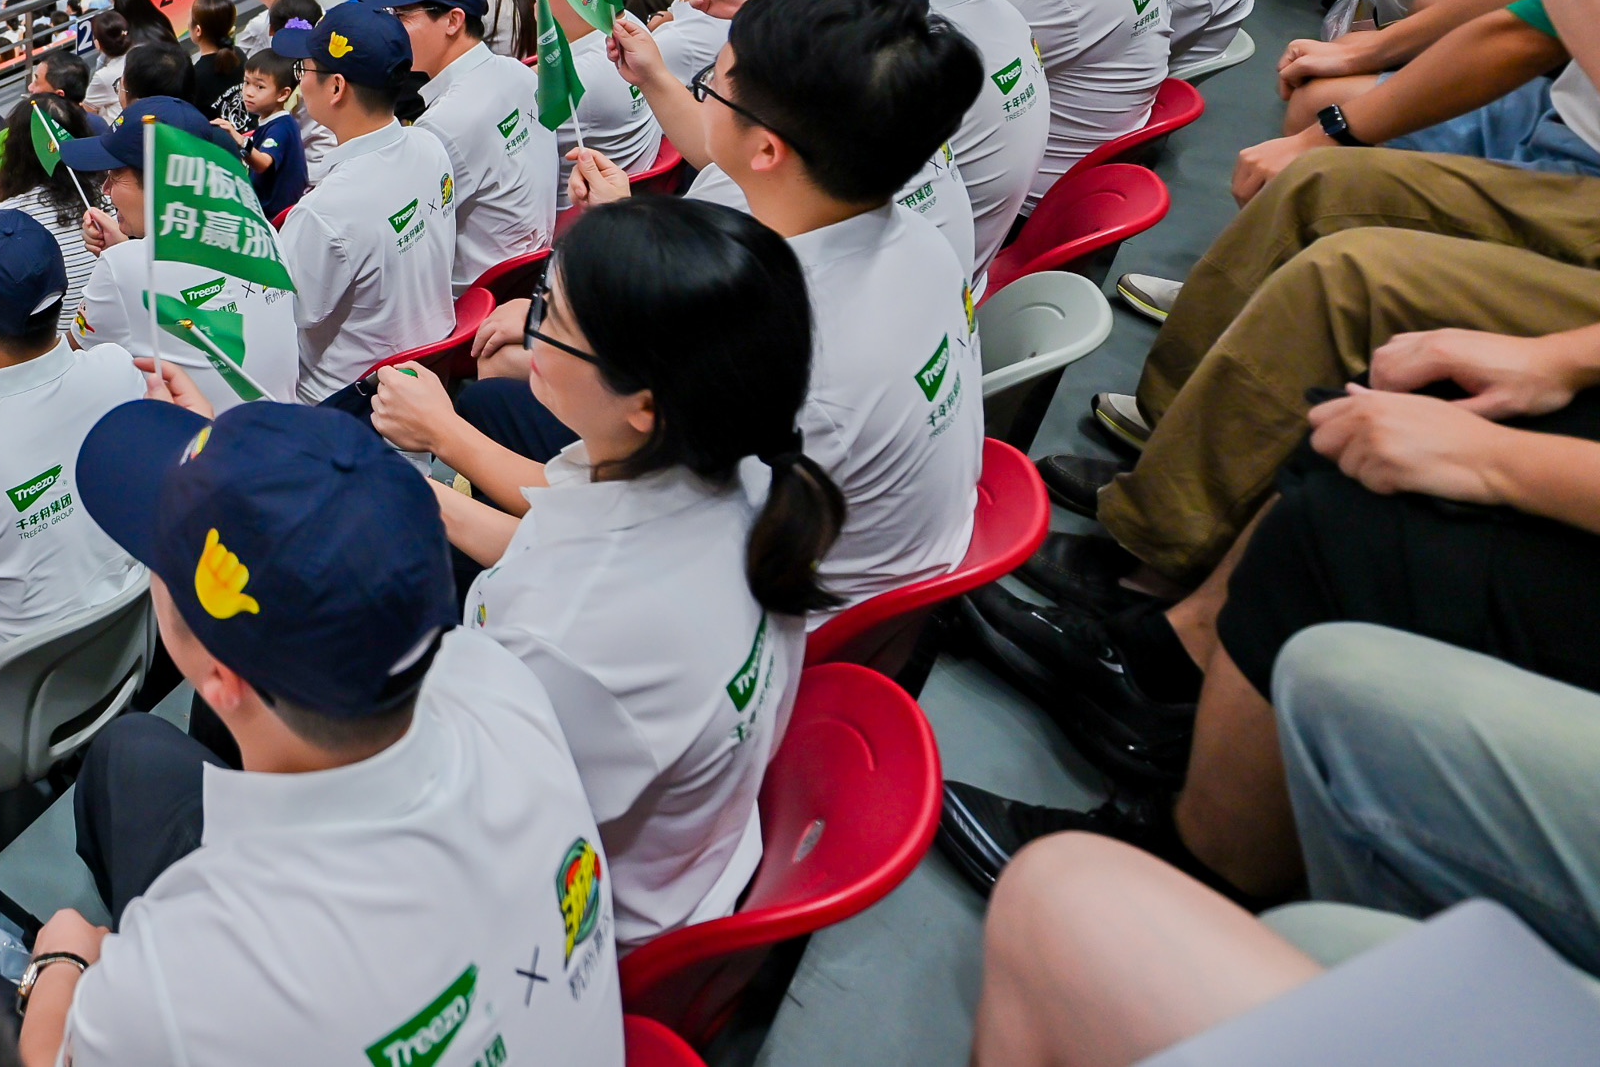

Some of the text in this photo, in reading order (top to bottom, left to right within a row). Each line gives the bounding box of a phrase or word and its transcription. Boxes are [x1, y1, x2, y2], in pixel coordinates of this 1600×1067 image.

[222, 84, 239, 98] NORTH
[187, 284, 221, 301] Treezo
[14, 475, 54, 501] Treezo
[16, 493, 72, 530] 千年舟集团
[18, 507, 74, 540] TREEZO GROUP
